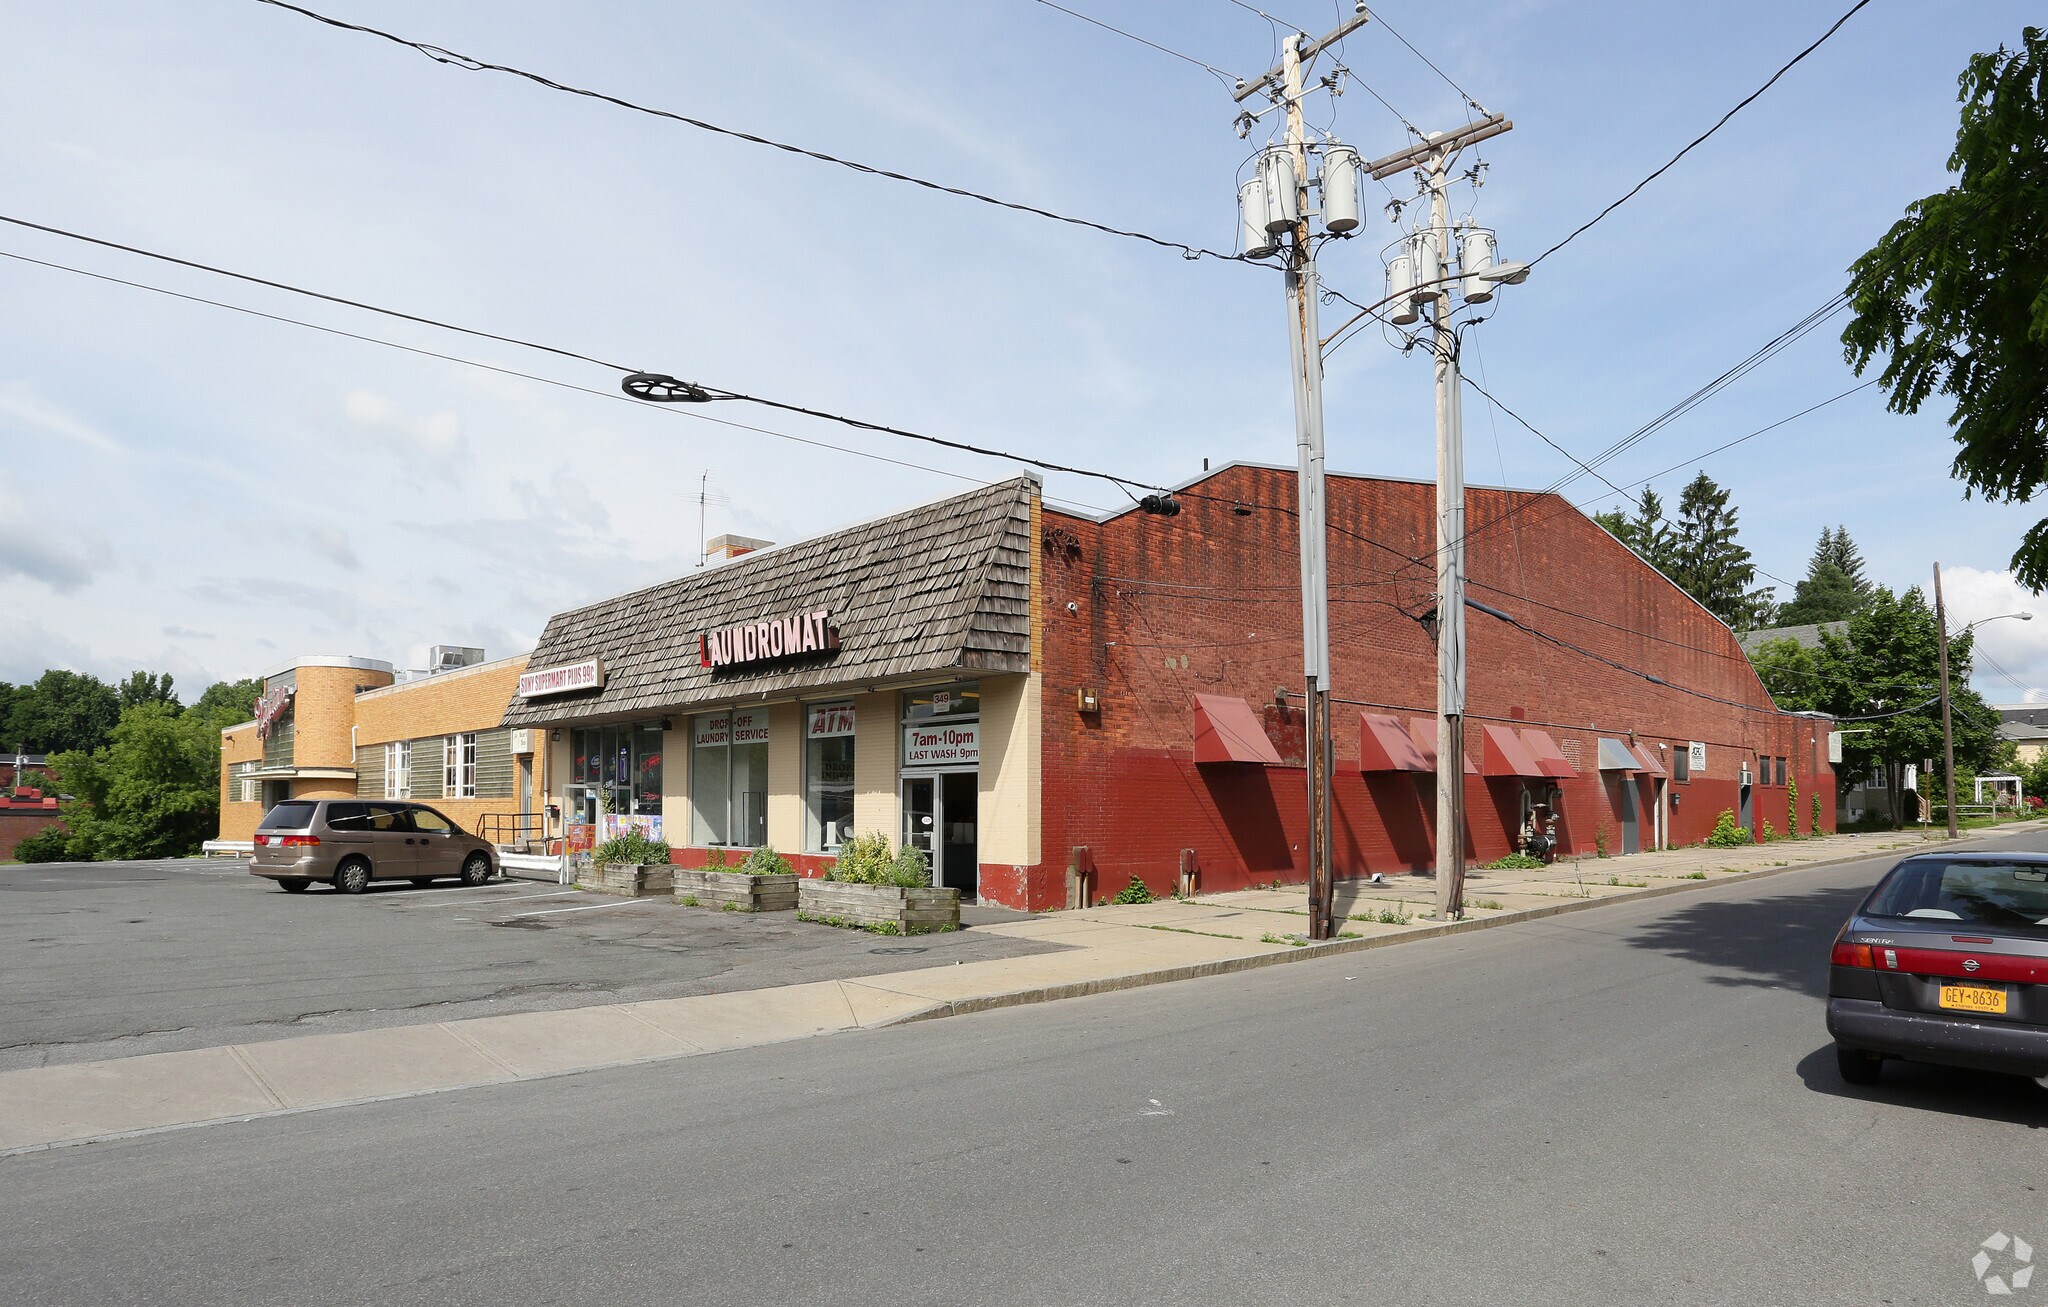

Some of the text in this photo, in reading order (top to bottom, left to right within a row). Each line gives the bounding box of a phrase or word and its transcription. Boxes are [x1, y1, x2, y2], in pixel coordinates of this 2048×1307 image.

[700, 610, 828, 668] LAUNDROMAT
[521, 677, 534, 693] SUNY
[535, 670, 567, 691] SUPERMART
[568, 667, 582, 685] PLUS
[934, 694, 949, 704] 349
[812, 706, 856, 734] ATM
[697, 728, 769, 744] LAUNDRY SERVICE
[912, 729, 974, 747] 7am-10pm
[909, 748, 979, 760] LAST WASH 9pm
